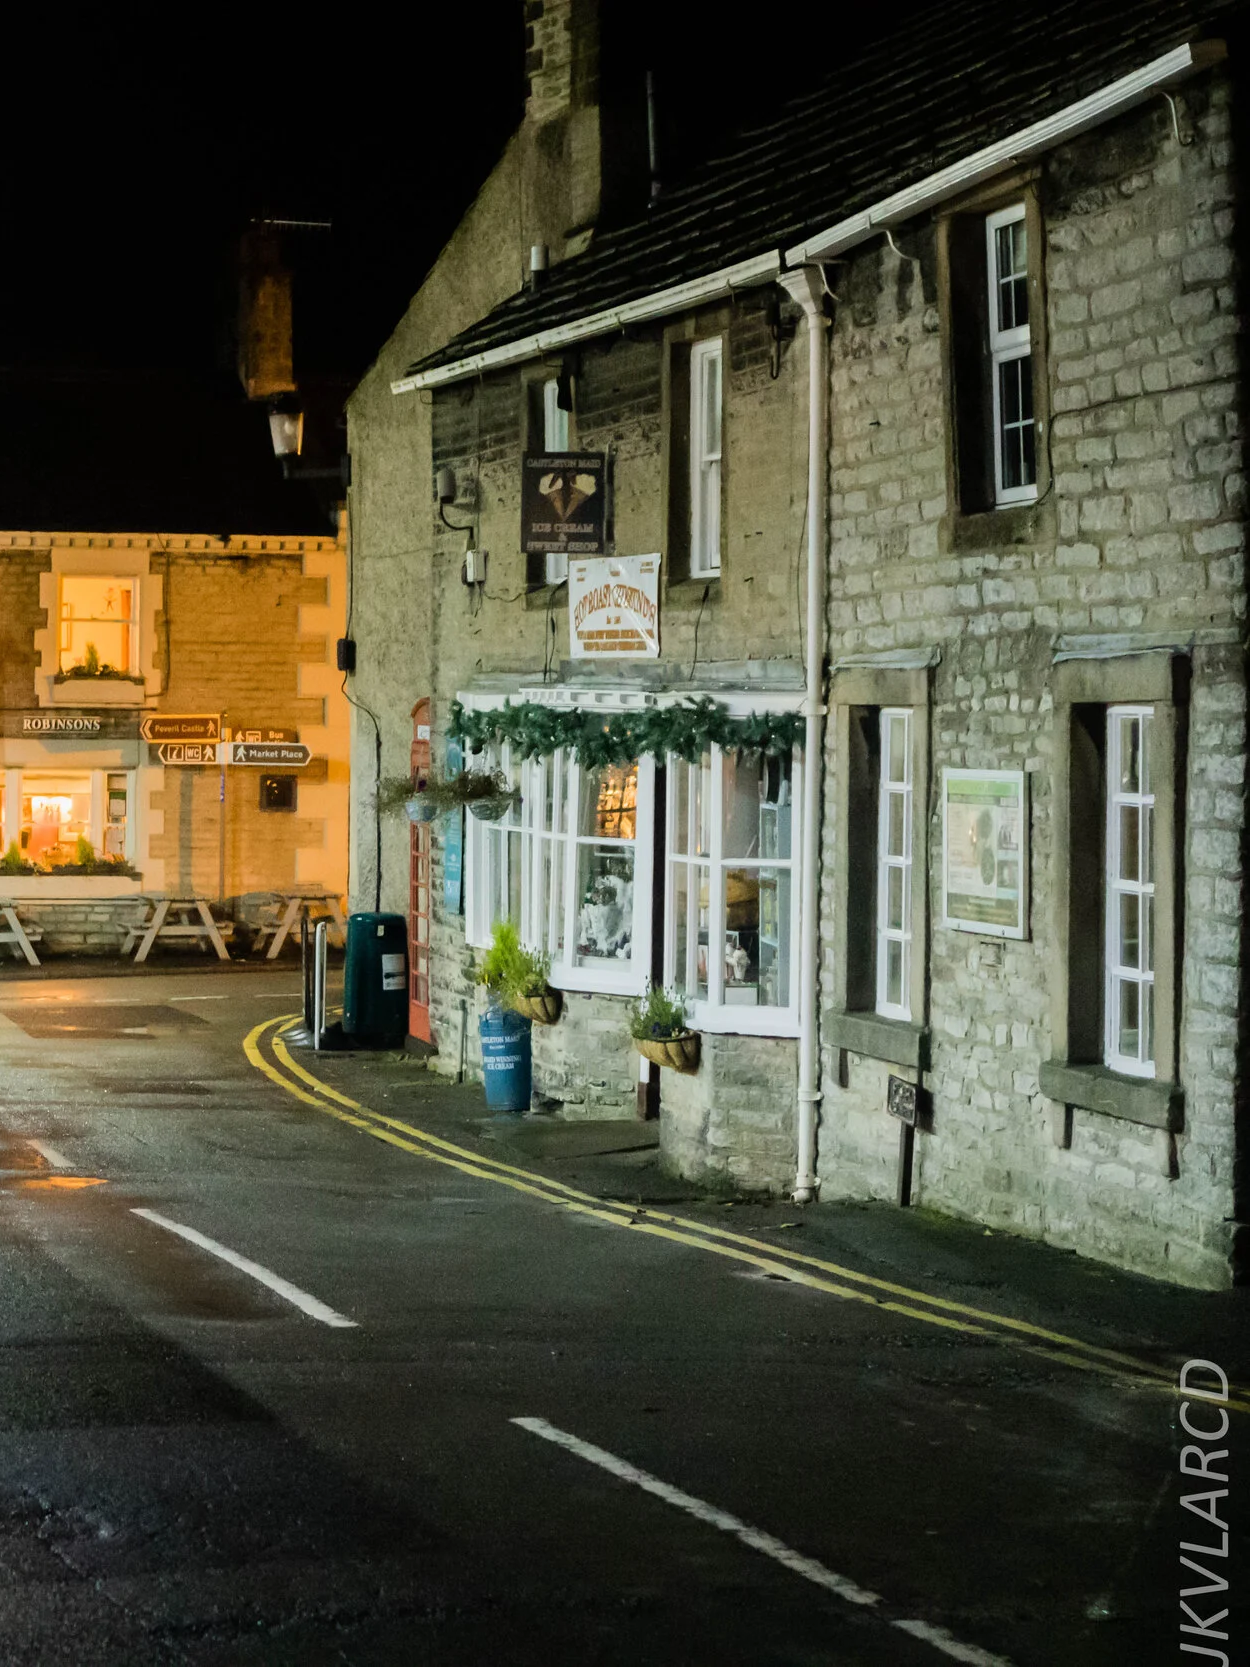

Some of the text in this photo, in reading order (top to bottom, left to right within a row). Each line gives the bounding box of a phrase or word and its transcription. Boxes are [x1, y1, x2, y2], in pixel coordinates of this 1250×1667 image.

[532, 523, 594, 533] ICE CREAM
[567, 541, 599, 551] SHOP
[23, 718, 102, 731] ROBINSONS
[154, 724, 205, 733] Peveril Castle
[269, 731, 284, 739] Bus
[187, 748, 200, 758] WC
[250, 750, 303, 759] Market Place
